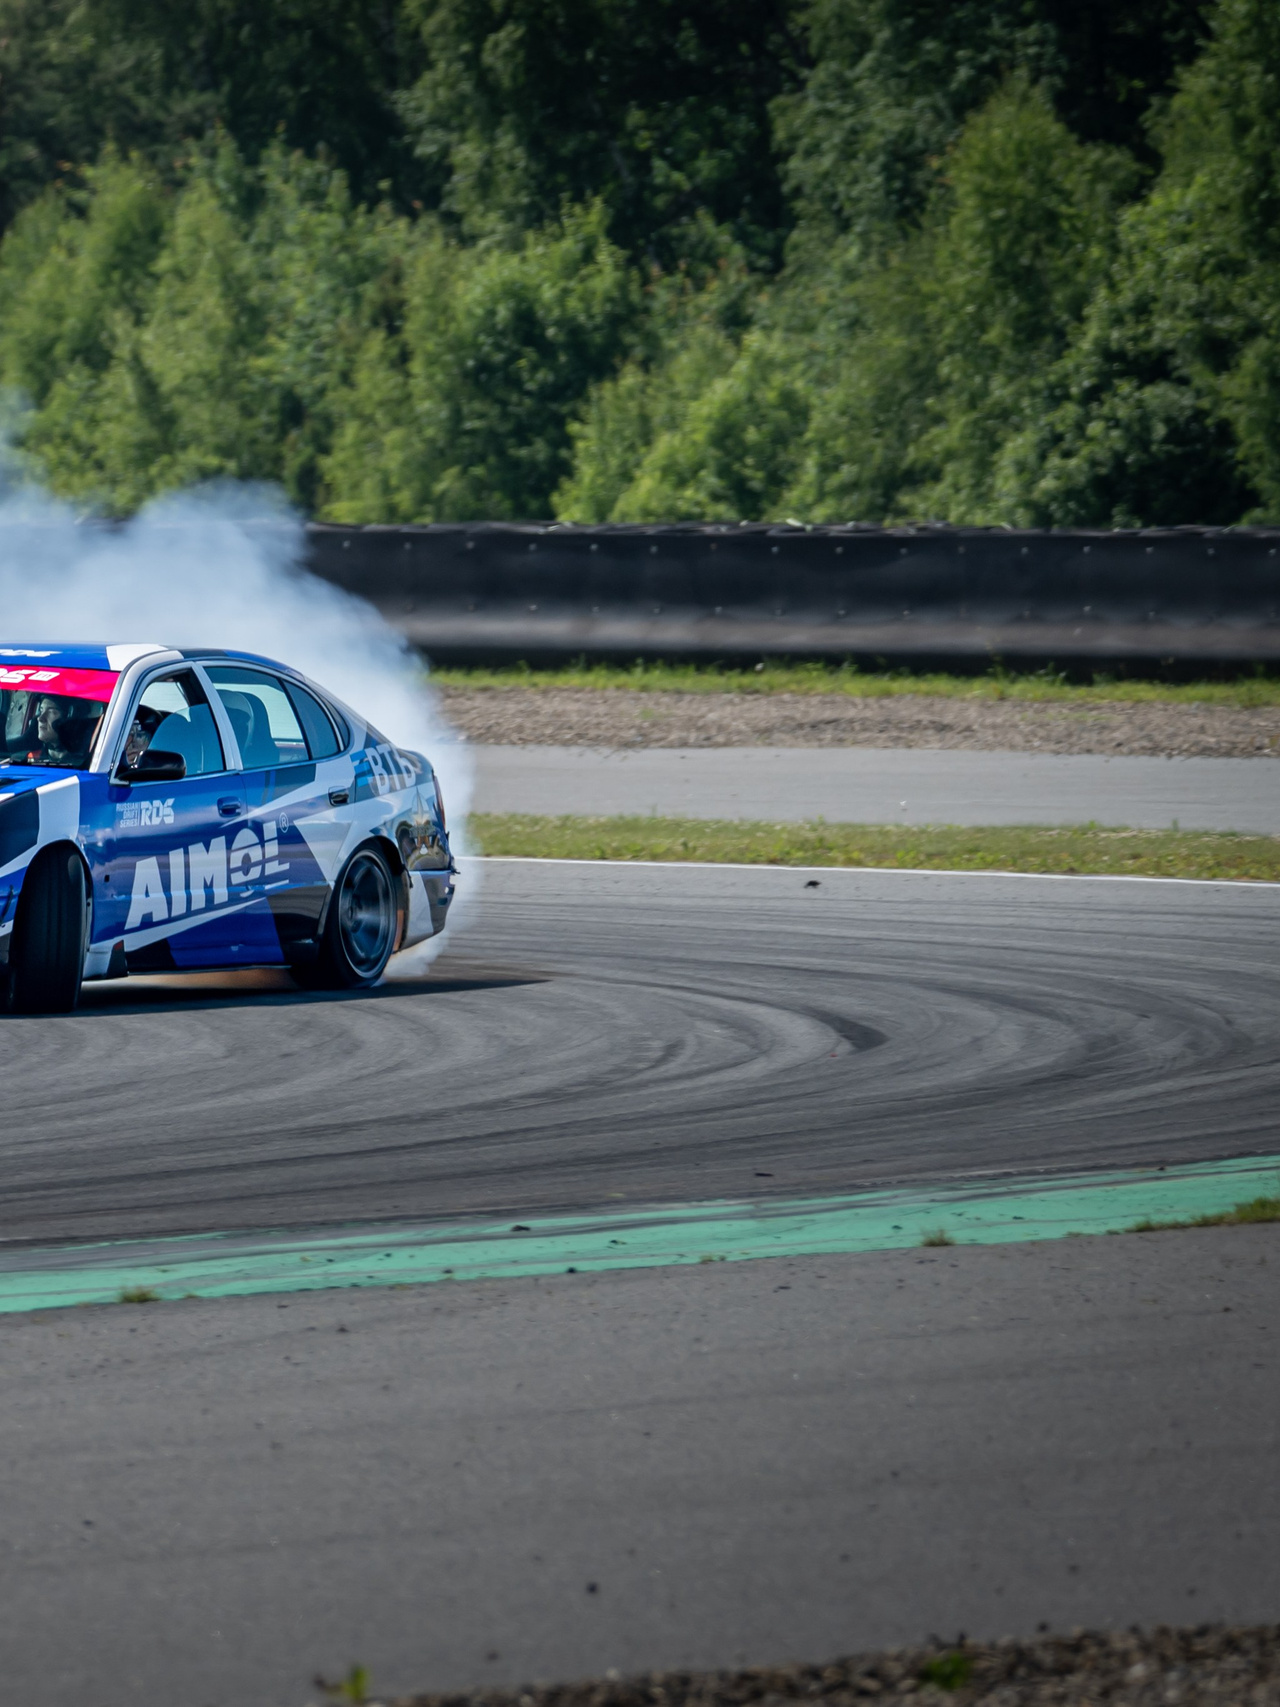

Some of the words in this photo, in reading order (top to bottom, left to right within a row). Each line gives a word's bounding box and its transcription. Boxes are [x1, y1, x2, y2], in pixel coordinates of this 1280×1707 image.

[120, 819, 138, 828] SERIES
[140, 798, 175, 826] RDS
[124, 820, 290, 931] AIMOL
